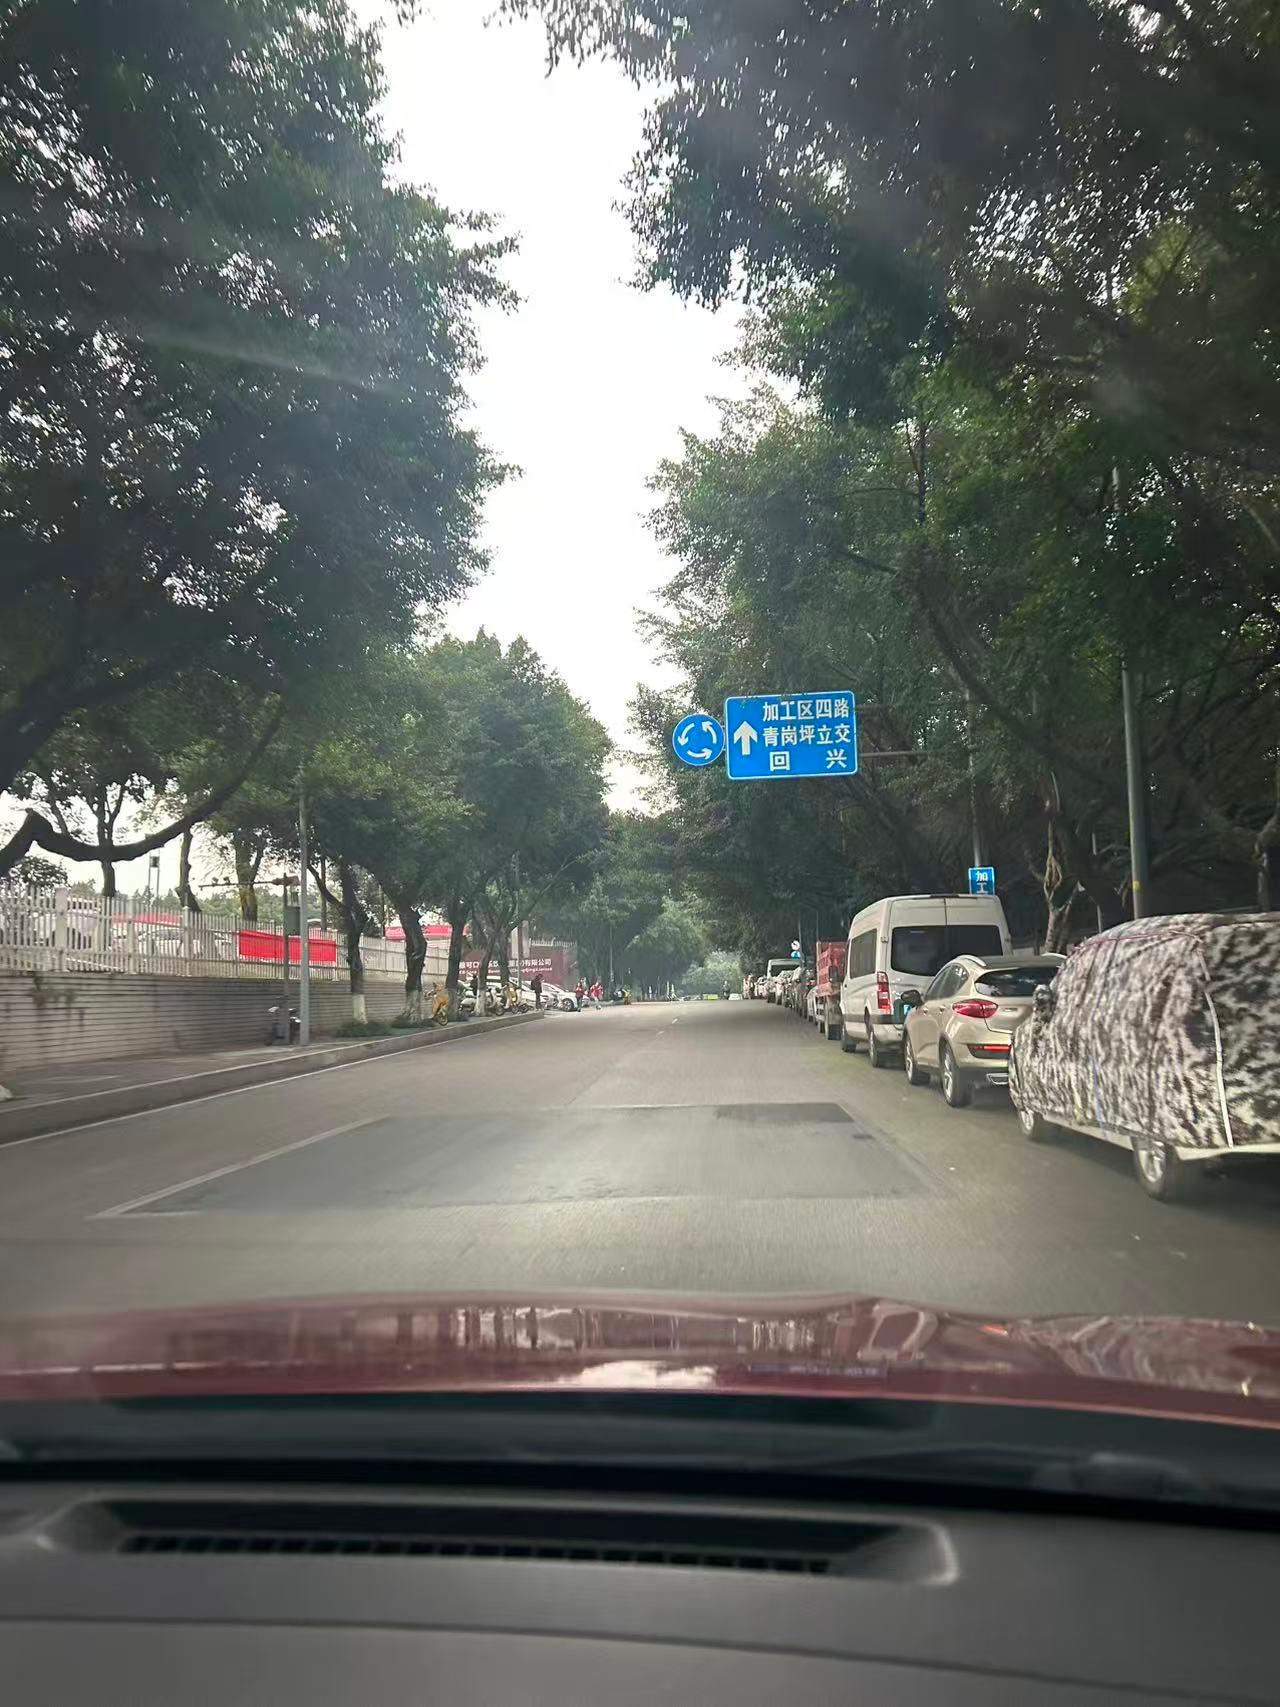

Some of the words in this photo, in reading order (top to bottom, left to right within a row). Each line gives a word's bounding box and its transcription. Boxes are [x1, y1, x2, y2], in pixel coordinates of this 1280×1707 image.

[762, 698, 849, 722] 加工区四路
[762, 723, 851, 747] 青岗坪立交
